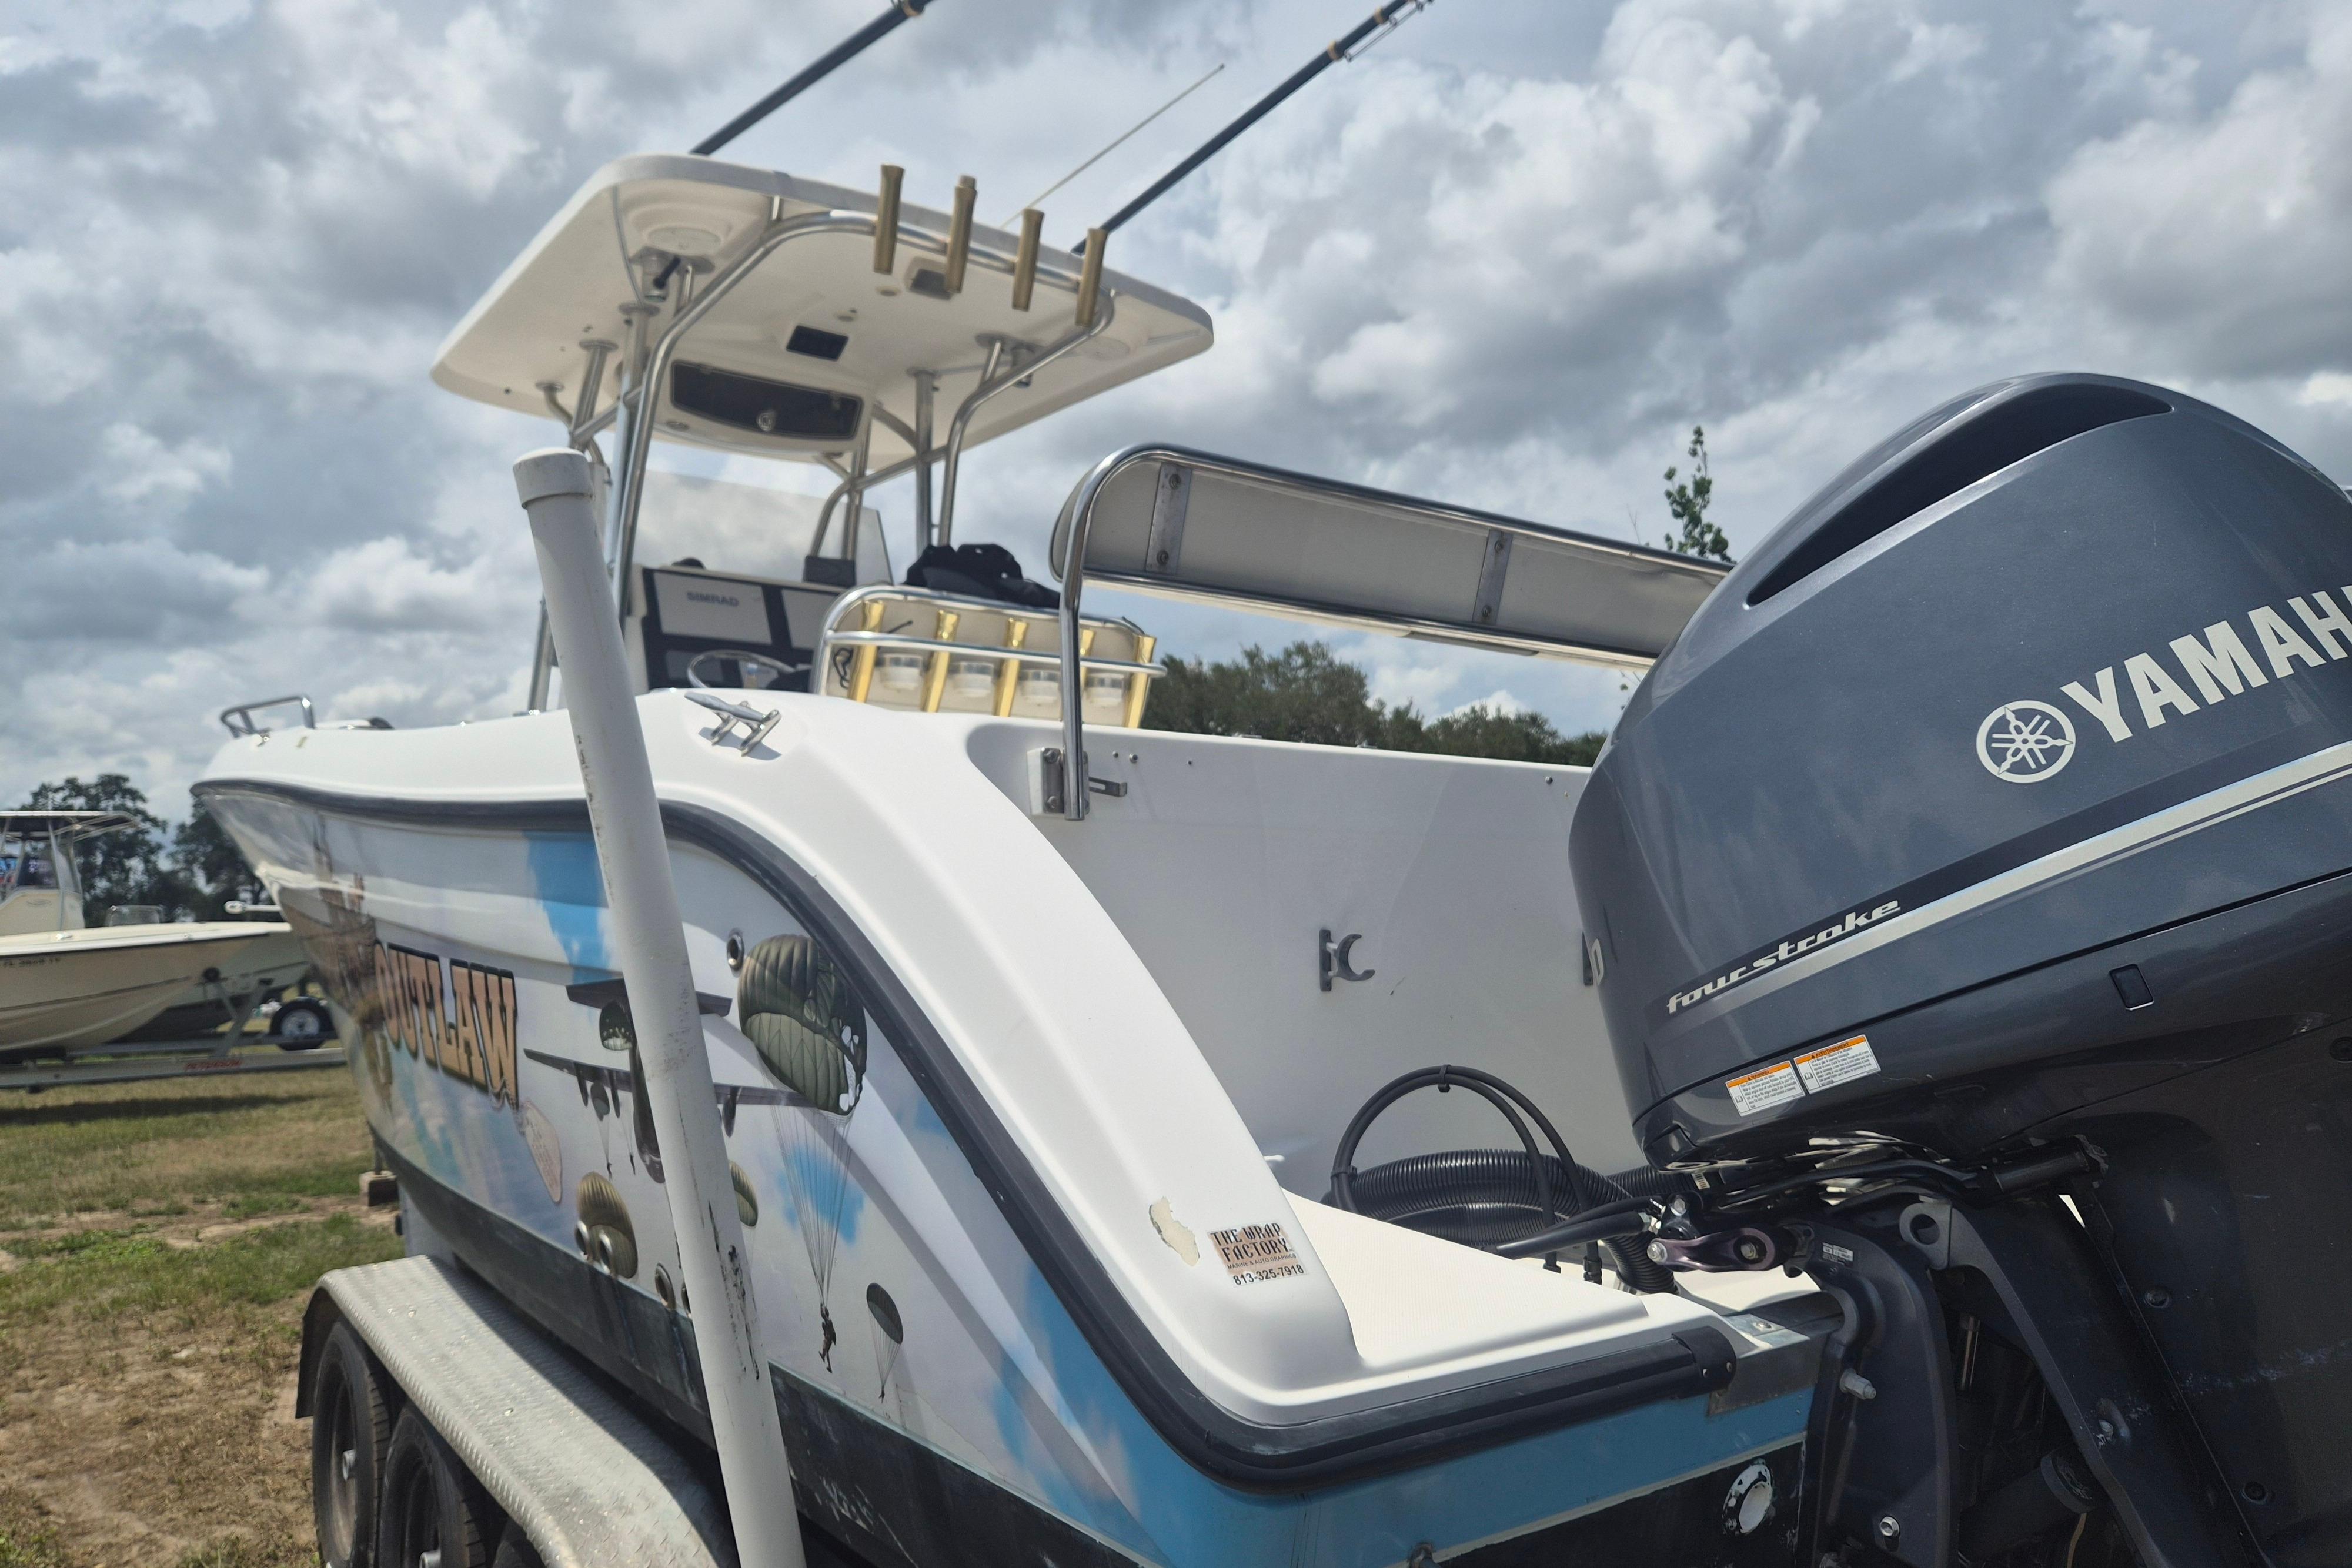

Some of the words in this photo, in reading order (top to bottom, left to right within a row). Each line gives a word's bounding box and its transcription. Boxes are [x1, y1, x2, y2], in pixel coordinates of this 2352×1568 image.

[686, 591, 739, 607] SIMRAD
[2059, 585, 2352, 743] YAMAH
[374, 939, 519, 1111] OUTLAW
[1210, 1229, 1242, 1246] THE
[1242, 1222, 1281, 1240] WRAP
[1221, 1238, 1289, 1262] FACTORY
[1227, 1260, 1250, 1270] MARINE
[1233, 1264, 1304, 1285] 813-325-7918
